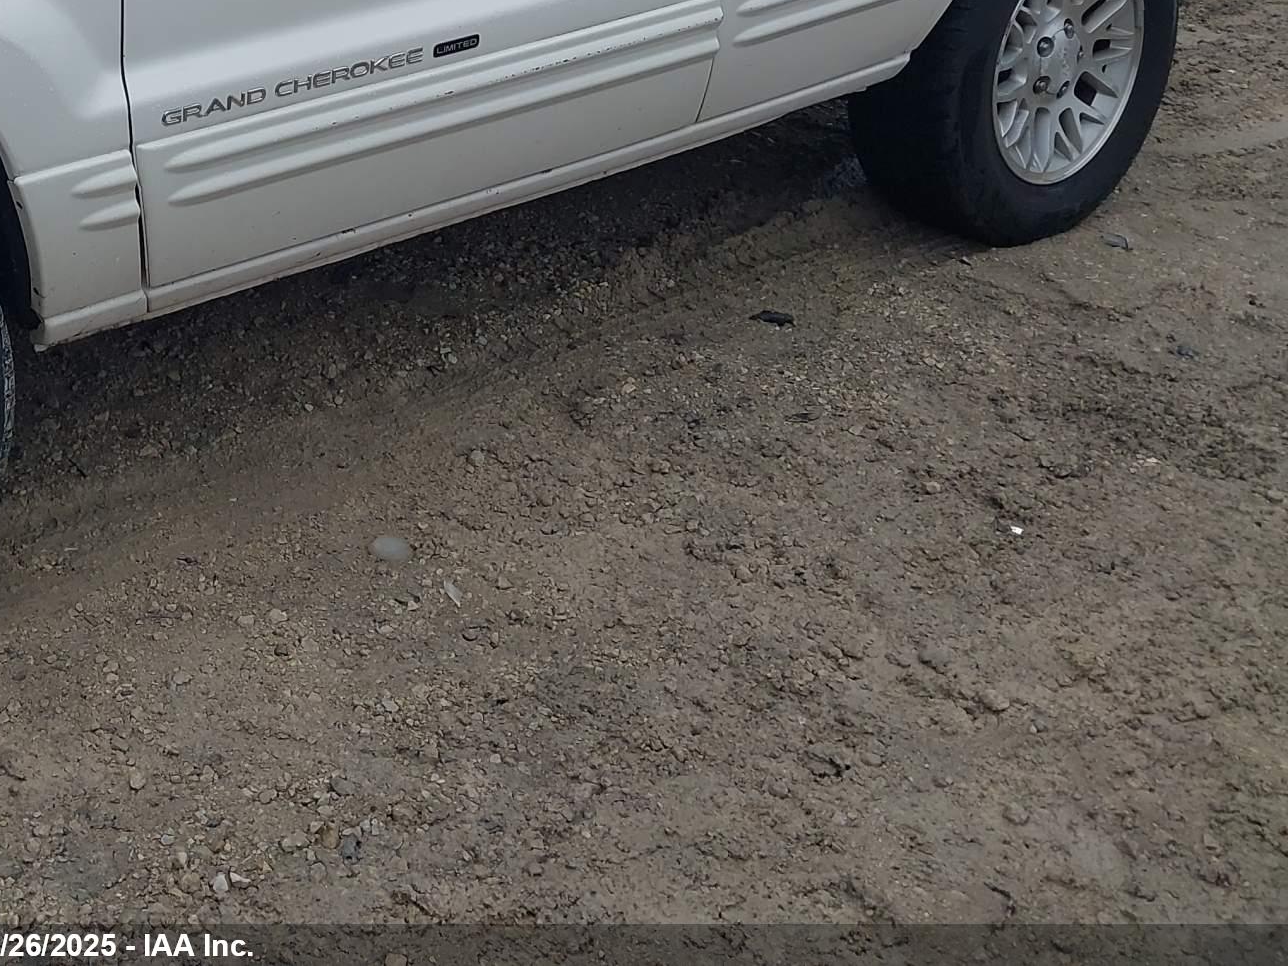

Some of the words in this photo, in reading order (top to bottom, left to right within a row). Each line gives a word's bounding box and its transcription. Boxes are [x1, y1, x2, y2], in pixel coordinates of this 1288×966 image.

[162, 88, 267, 126] GRAND
[274, 47, 424, 98] CHEROKEE
[436, 38, 478, 54] LIMITED
